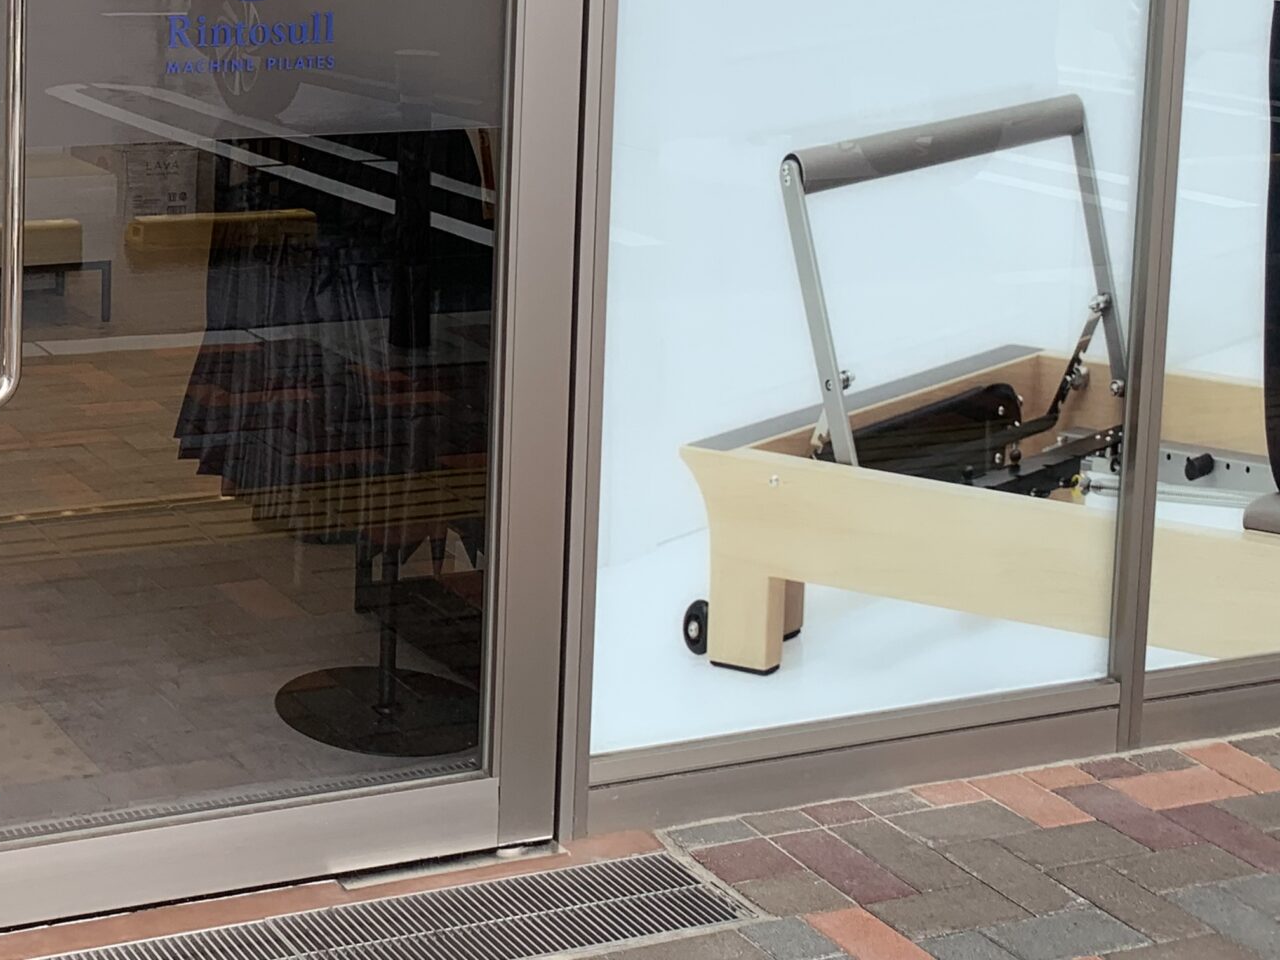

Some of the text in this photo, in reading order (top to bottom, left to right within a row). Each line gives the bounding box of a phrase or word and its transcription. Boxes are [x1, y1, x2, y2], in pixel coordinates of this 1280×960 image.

[167, 11, 334, 49] Rintosull
[166, 55, 335, 73] MACHINE PILATES
